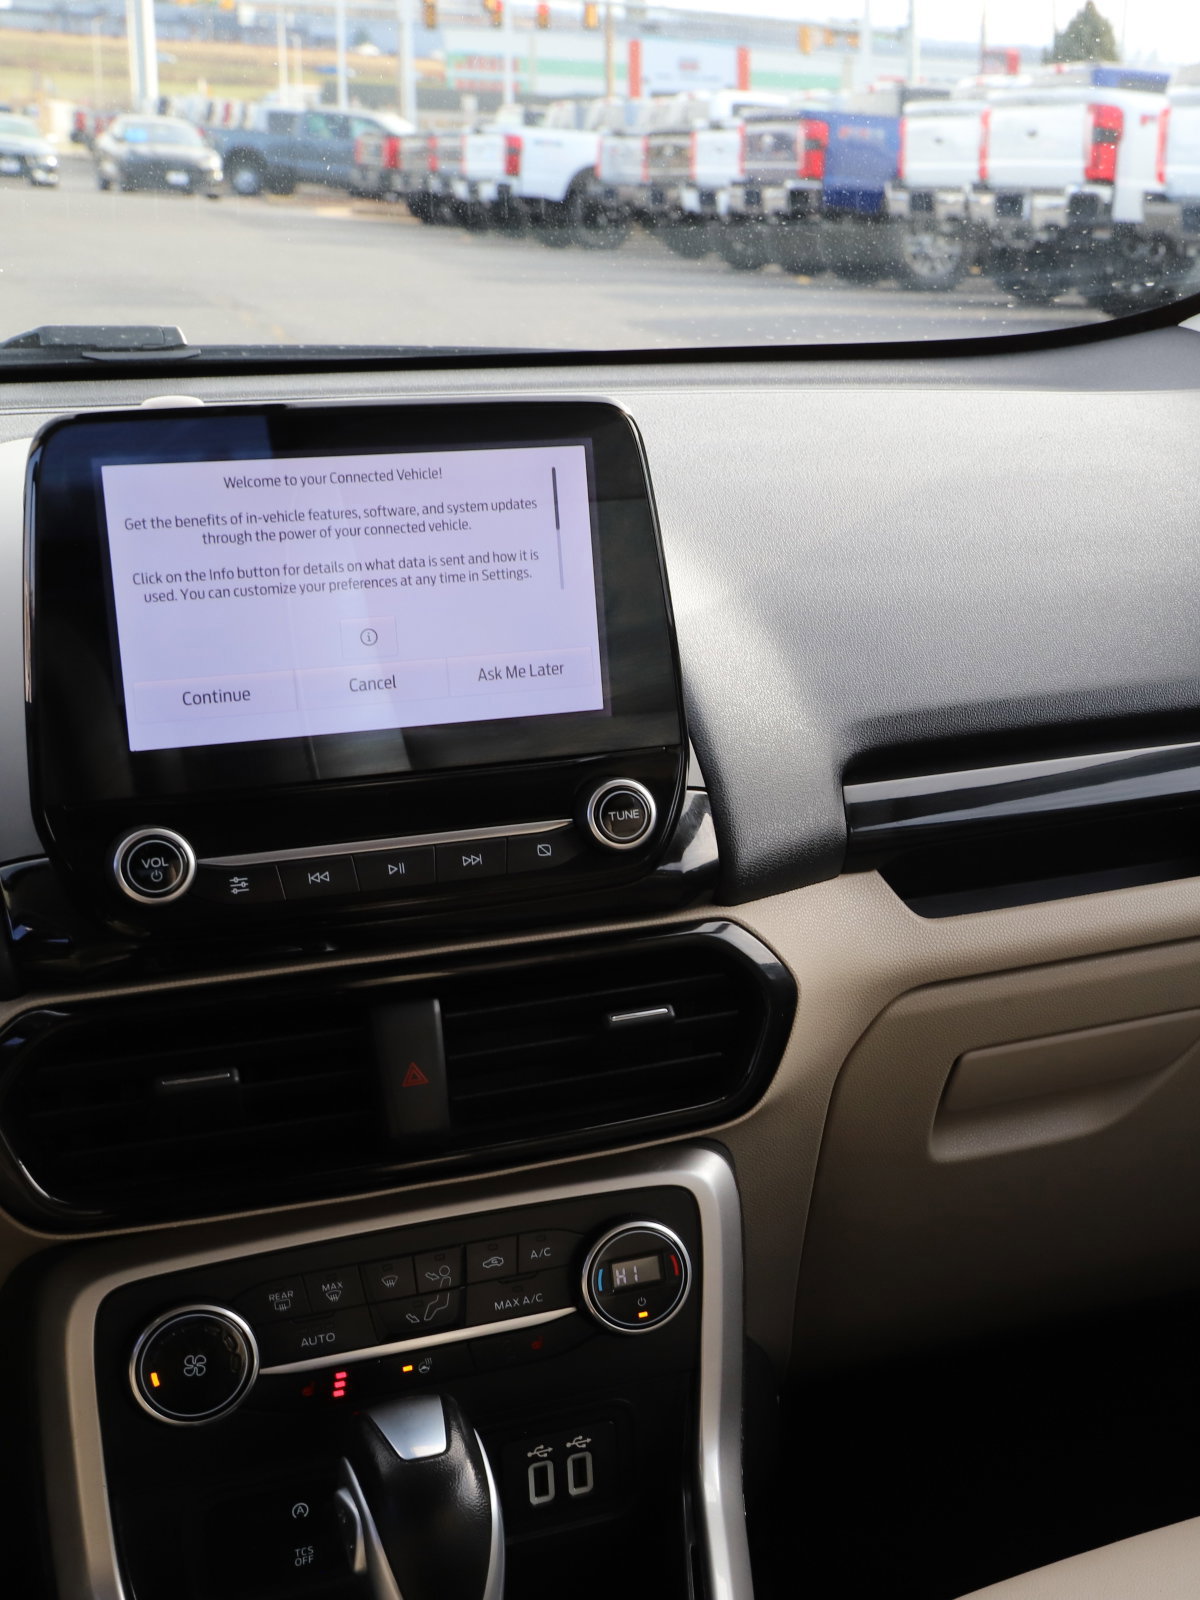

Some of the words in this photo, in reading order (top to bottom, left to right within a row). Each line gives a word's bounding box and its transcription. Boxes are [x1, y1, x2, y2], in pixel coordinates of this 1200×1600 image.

[224, 476, 281, 489] Welcome
[284, 474, 298, 486] to
[300, 474, 326, 488] your
[330, 469, 394, 484] Connected
[396, 468, 443, 482] Vehicle!
[124, 518, 148, 530] Get
[150, 516, 172, 529] the
[175, 514, 228, 528] benefits
[230, 512, 245, 525] of
[246, 510, 306, 524] in-vehicle
[308, 507, 361, 520] features,
[364, 504, 420, 518] software,
[422, 502, 444, 515] and
[446, 500, 488, 514] system
[490, 498, 538, 512] updates
[202, 532, 252, 546] through
[255, 529, 276, 542] the
[279, 528, 316, 542] power
[319, 526, 333, 538] of
[336, 526, 362, 538] your
[364, 520, 426, 536] connected
[428, 519, 472, 532] vehicle.
[132, 571, 163, 586] Click
[165, 573, 182, 584] on
[185, 569, 206, 582] the
[209, 568, 234, 581] Info
[237, 566, 280, 580] button
[282, 564, 300, 576] for
[303, 560, 344, 576] details
[347, 562, 362, 572] on
[364, 558, 396, 570] what
[398, 556, 426, 569] data
[428, 554, 438, 567] is
[440, 554, 465, 566] sent
[468, 552, 490, 565] and
[492, 551, 517, 563] how
[520, 550, 528, 562] it
[530, 549, 539, 560] is
[144, 589, 178, 603] used.
[180, 588, 205, 601] You
[208, 589, 230, 599] can
[233, 582, 297, 597] customize
[299, 582, 326, 594] your
[328, 577, 398, 593] preferences
[400, 574, 412, 586] at
[415, 574, 438, 586] any
[439, 571, 466, 584] time
[468, 570, 479, 582] in
[482, 567, 532, 582] Settings.
[478, 666, 502, 682] Ask
[506, 664, 527, 679] Me
[529, 662, 565, 678] Later
[349, 674, 397, 694] Cancel
[182, 687, 251, 706] Continue
[608, 809, 640, 821] TUNE
[141, 857, 169, 868] VOL
[530, 1247, 551, 1259] A/C
[268, 1290, 294, 1301] REAR
[322, 1281, 344, 1292] MAX
[494, 1298, 519, 1311] MAX
[522, 1292, 543, 1304] A/C
[301, 1332, 336, 1347] AUTO
[294, 1546, 314, 1557] TCS
[294, 1555, 314, 1566] OFF
